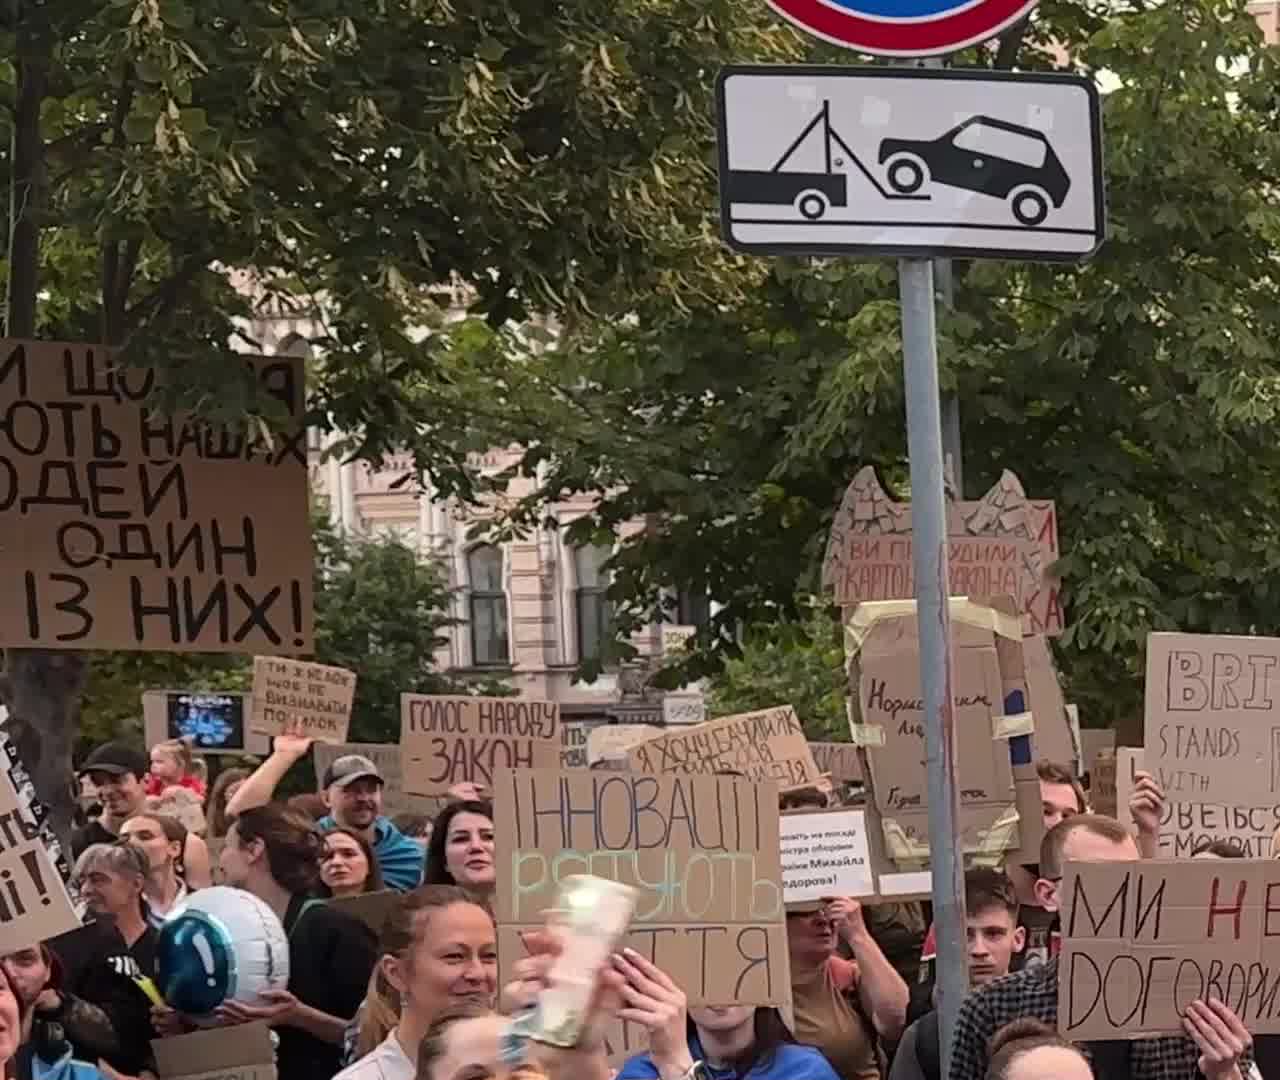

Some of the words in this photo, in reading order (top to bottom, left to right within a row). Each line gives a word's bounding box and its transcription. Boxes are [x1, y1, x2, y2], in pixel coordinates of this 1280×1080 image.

[56, 515, 257, 578] ОДИН
[24, 570, 94, 643] ІЗ
[130, 574, 305, 648] НИХ!
[409, 701, 469, 734] ГОЛОС
[478, 702, 558, 739] НАРОДУ
[1159, 724, 1241, 760] STANDS
[429, 737, 534, 784] ЗАКОН
[783, 873, 837, 889] едорова!
[810, 856, 865, 869] Михайла
[1068, 871, 1166, 941] МИ
[517, 926, 772, 1000] ТТЯ
